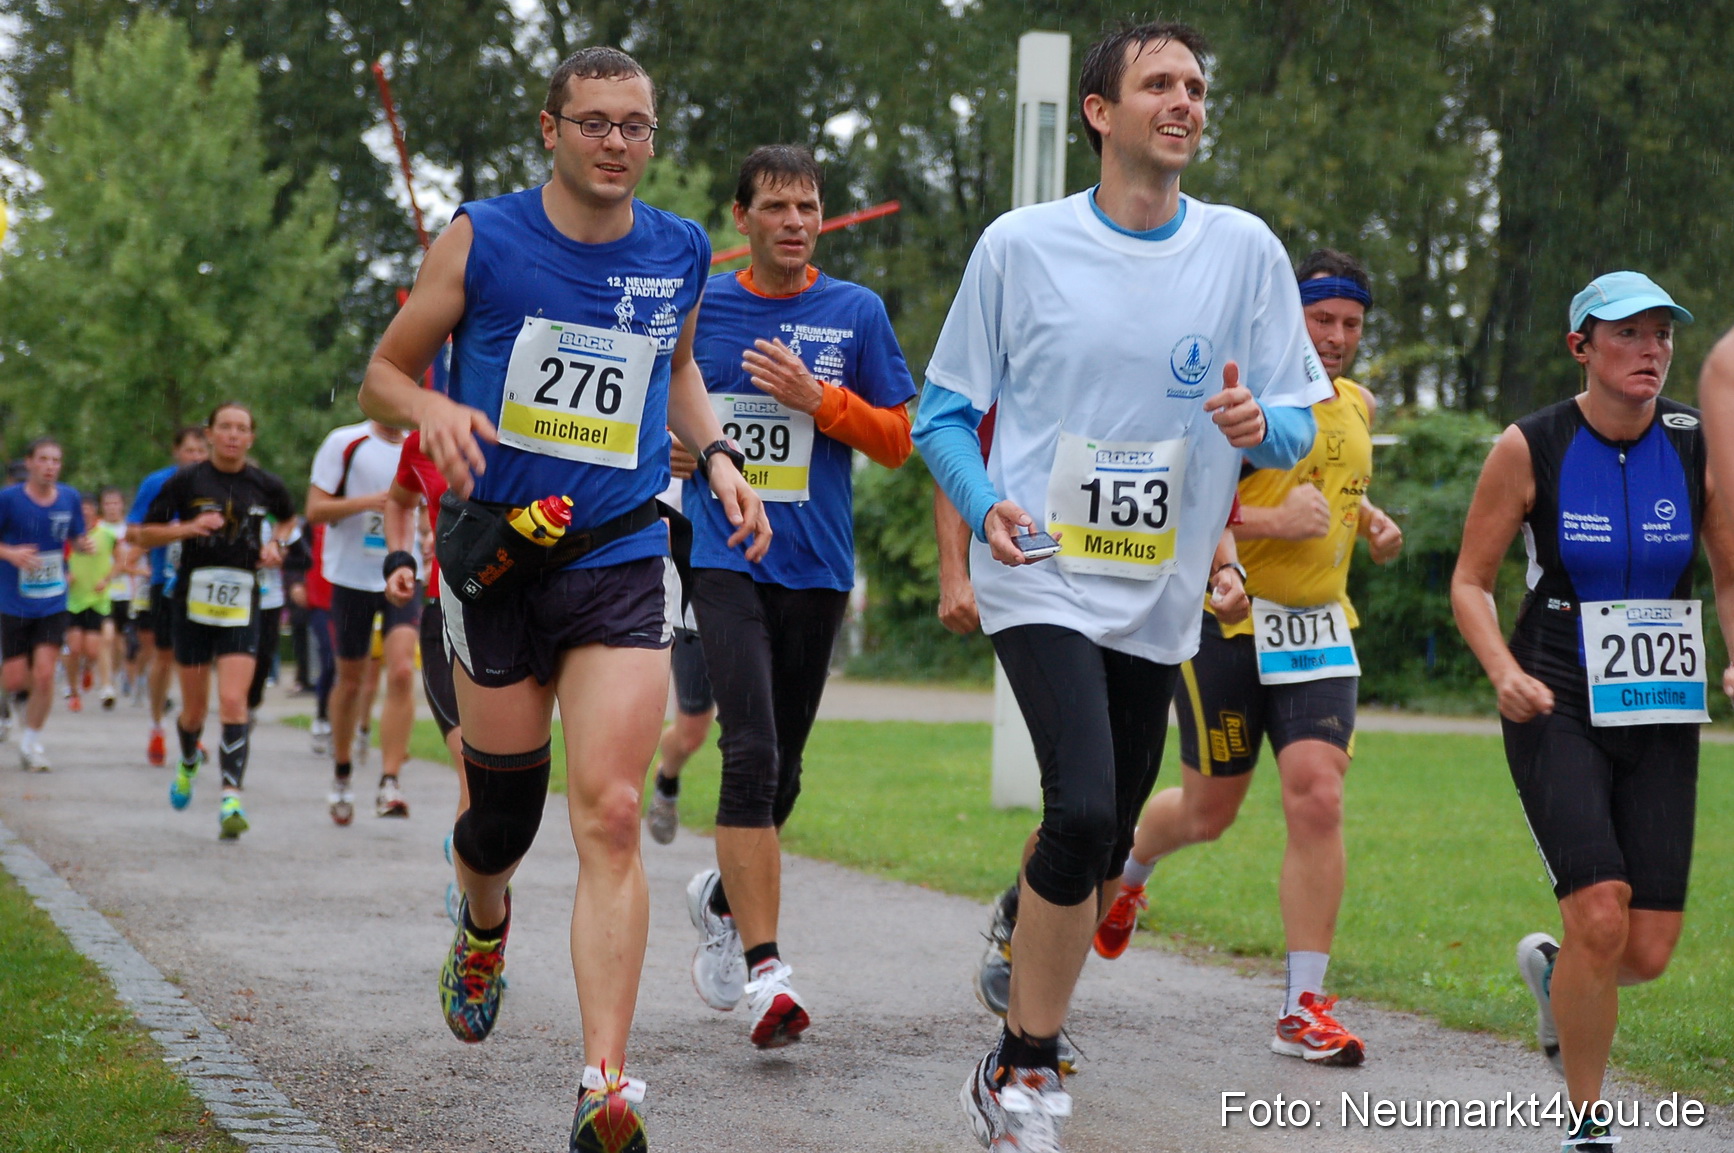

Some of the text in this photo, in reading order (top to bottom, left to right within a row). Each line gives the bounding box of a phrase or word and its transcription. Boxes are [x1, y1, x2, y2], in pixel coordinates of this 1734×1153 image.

[606, 276, 624, 287] 12.
[623, 287, 676, 298] STADTLAUF
[559, 331, 614, 351] BOCK
[780, 324, 854, 339] 12. NEUMARKTER
[792, 332, 842, 344] STADTLAUF
[533, 356, 625, 416] 276
[733, 401, 779, 414] BOCK
[533, 418, 609, 445] michael
[1095, 449, 1155, 465] BOCK
[1080, 478, 1170, 530] 153
[1084, 534, 1157, 561] Markus
[1564, 532, 1612, 543] Lufthansa
[1643, 533, 1663, 544] City
[206, 583, 241, 606] 162
[1626, 607, 1673, 620] BOCK
[1264, 612, 1338, 648] 3071
[1601, 632, 1697, 679] 2025
[1621, 688, 1687, 707] Christine
